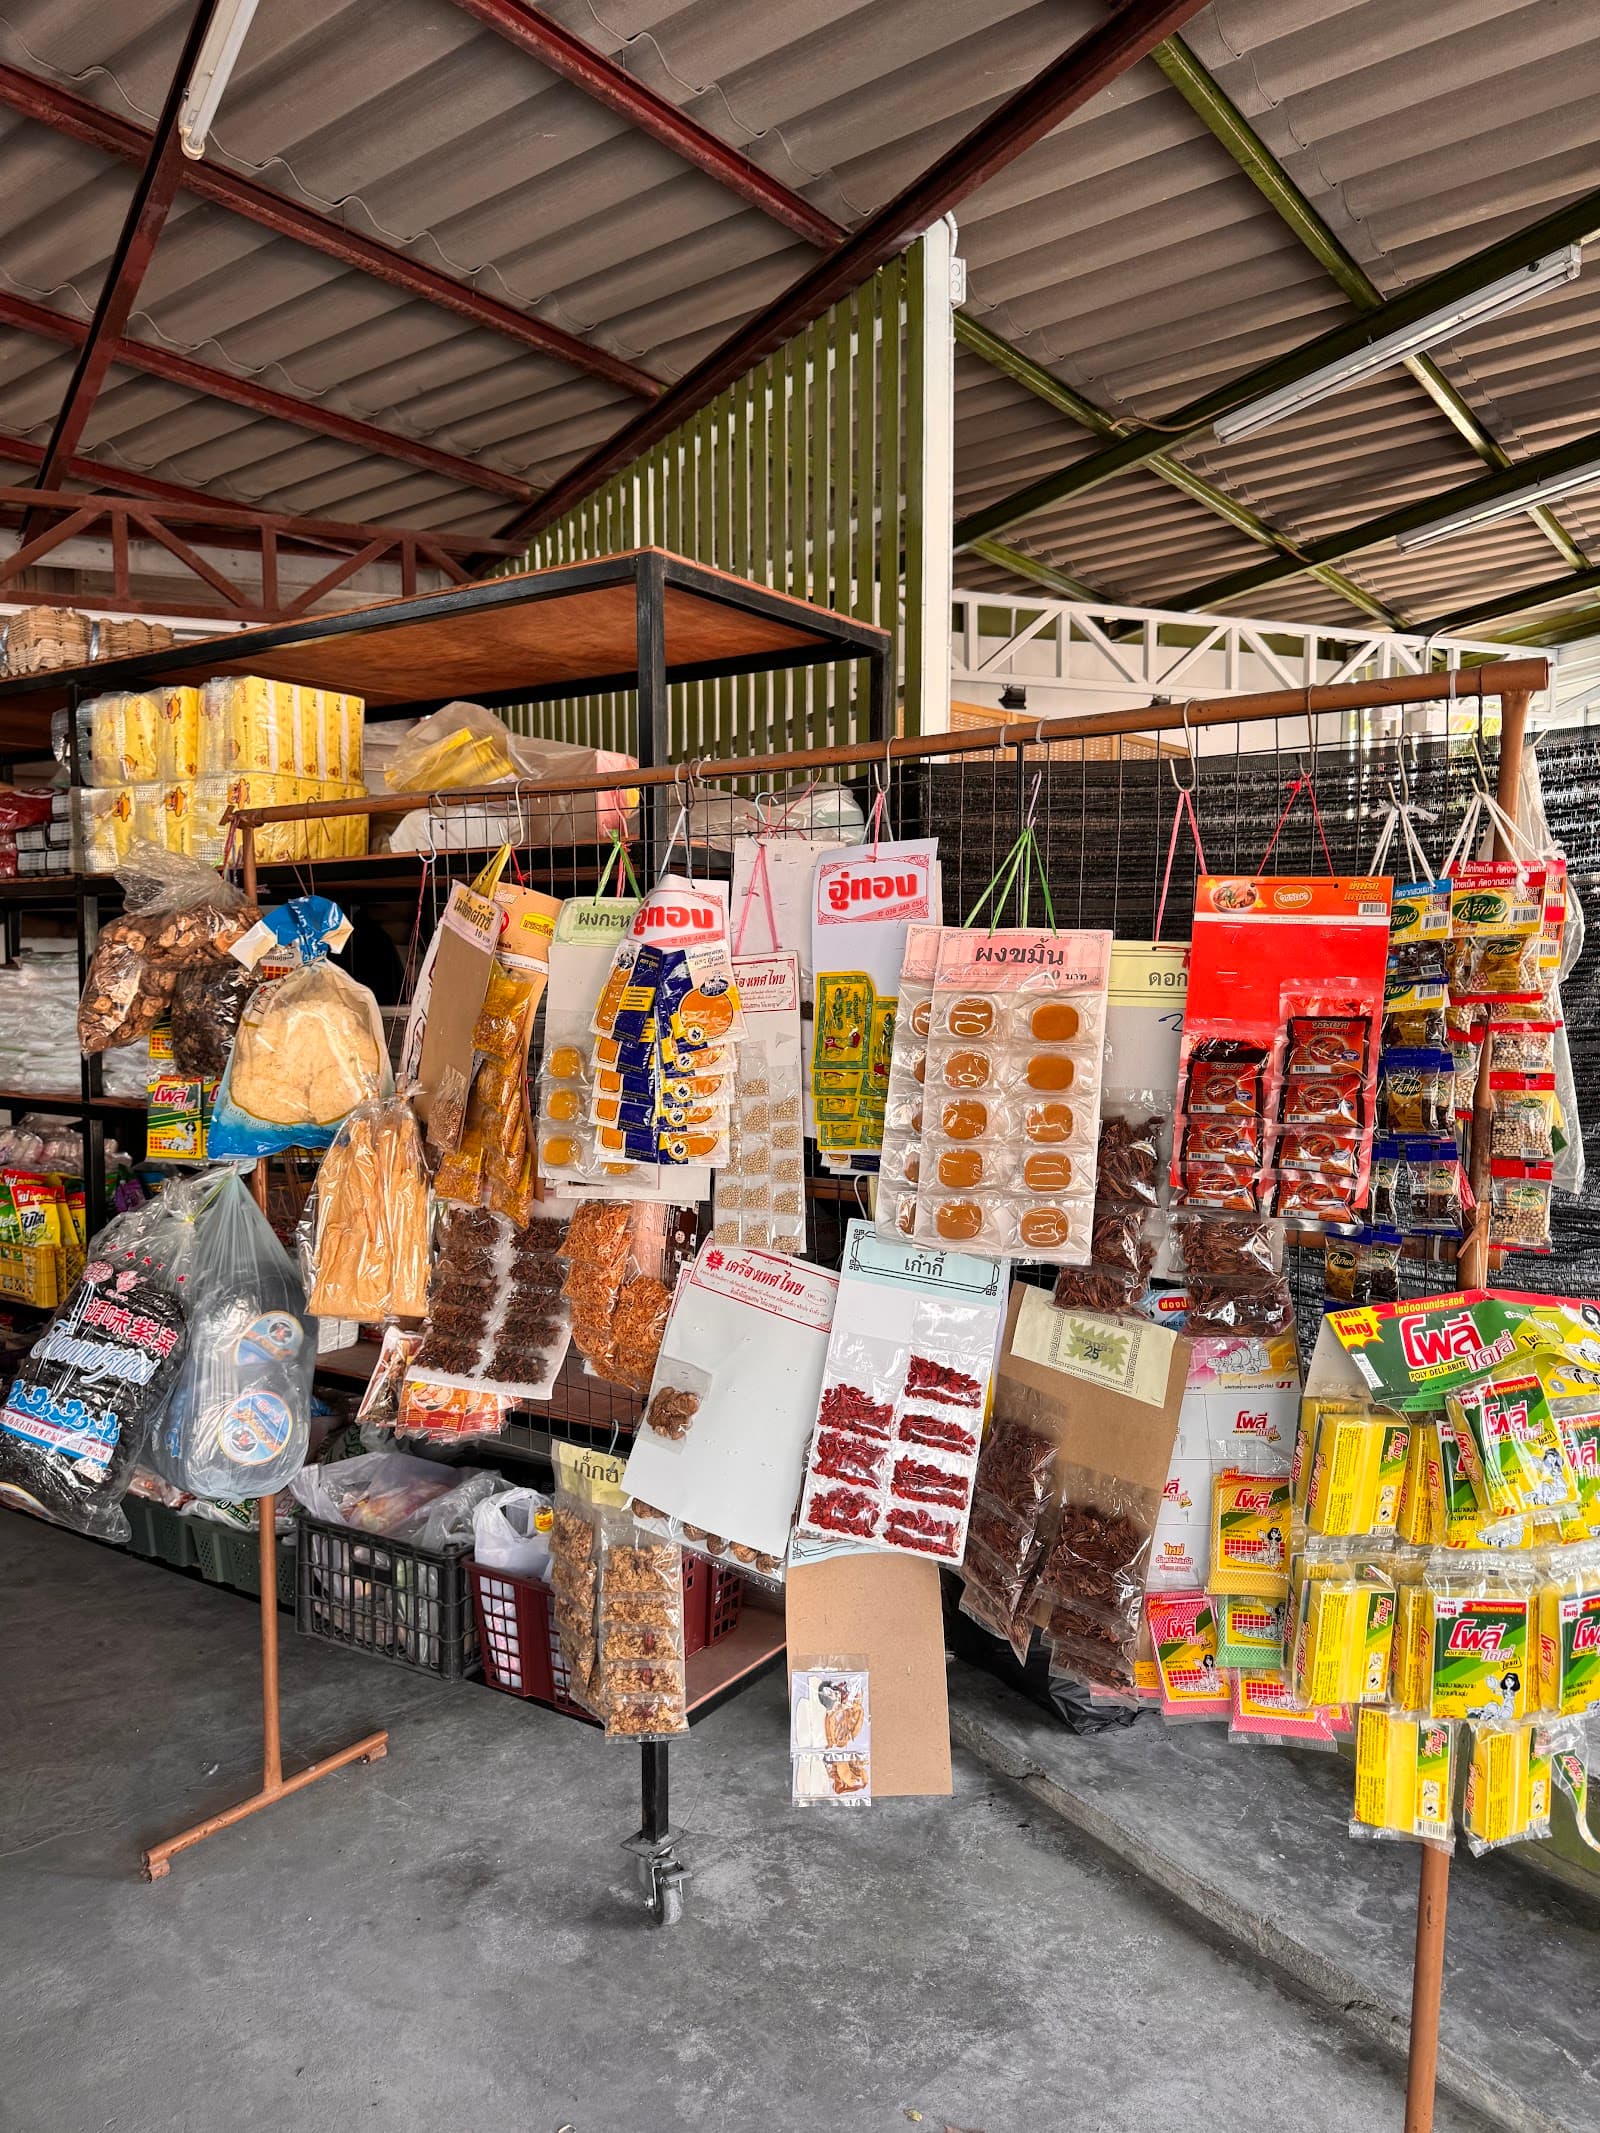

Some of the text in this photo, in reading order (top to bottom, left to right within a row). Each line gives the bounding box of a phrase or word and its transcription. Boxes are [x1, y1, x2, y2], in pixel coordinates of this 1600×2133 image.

[975, 938, 1064, 966] ผงขมิ้น
[1335, 1318, 1374, 1337] ใหญ่
[1400, 1312, 1485, 1368] โพลี
[1082, 1344, 1101, 1360] 25
[1410, 1371, 1430, 1382] POLY
[1236, 1410, 1268, 1429] โพลี
[1449, 1619, 1506, 1650] โพลี
